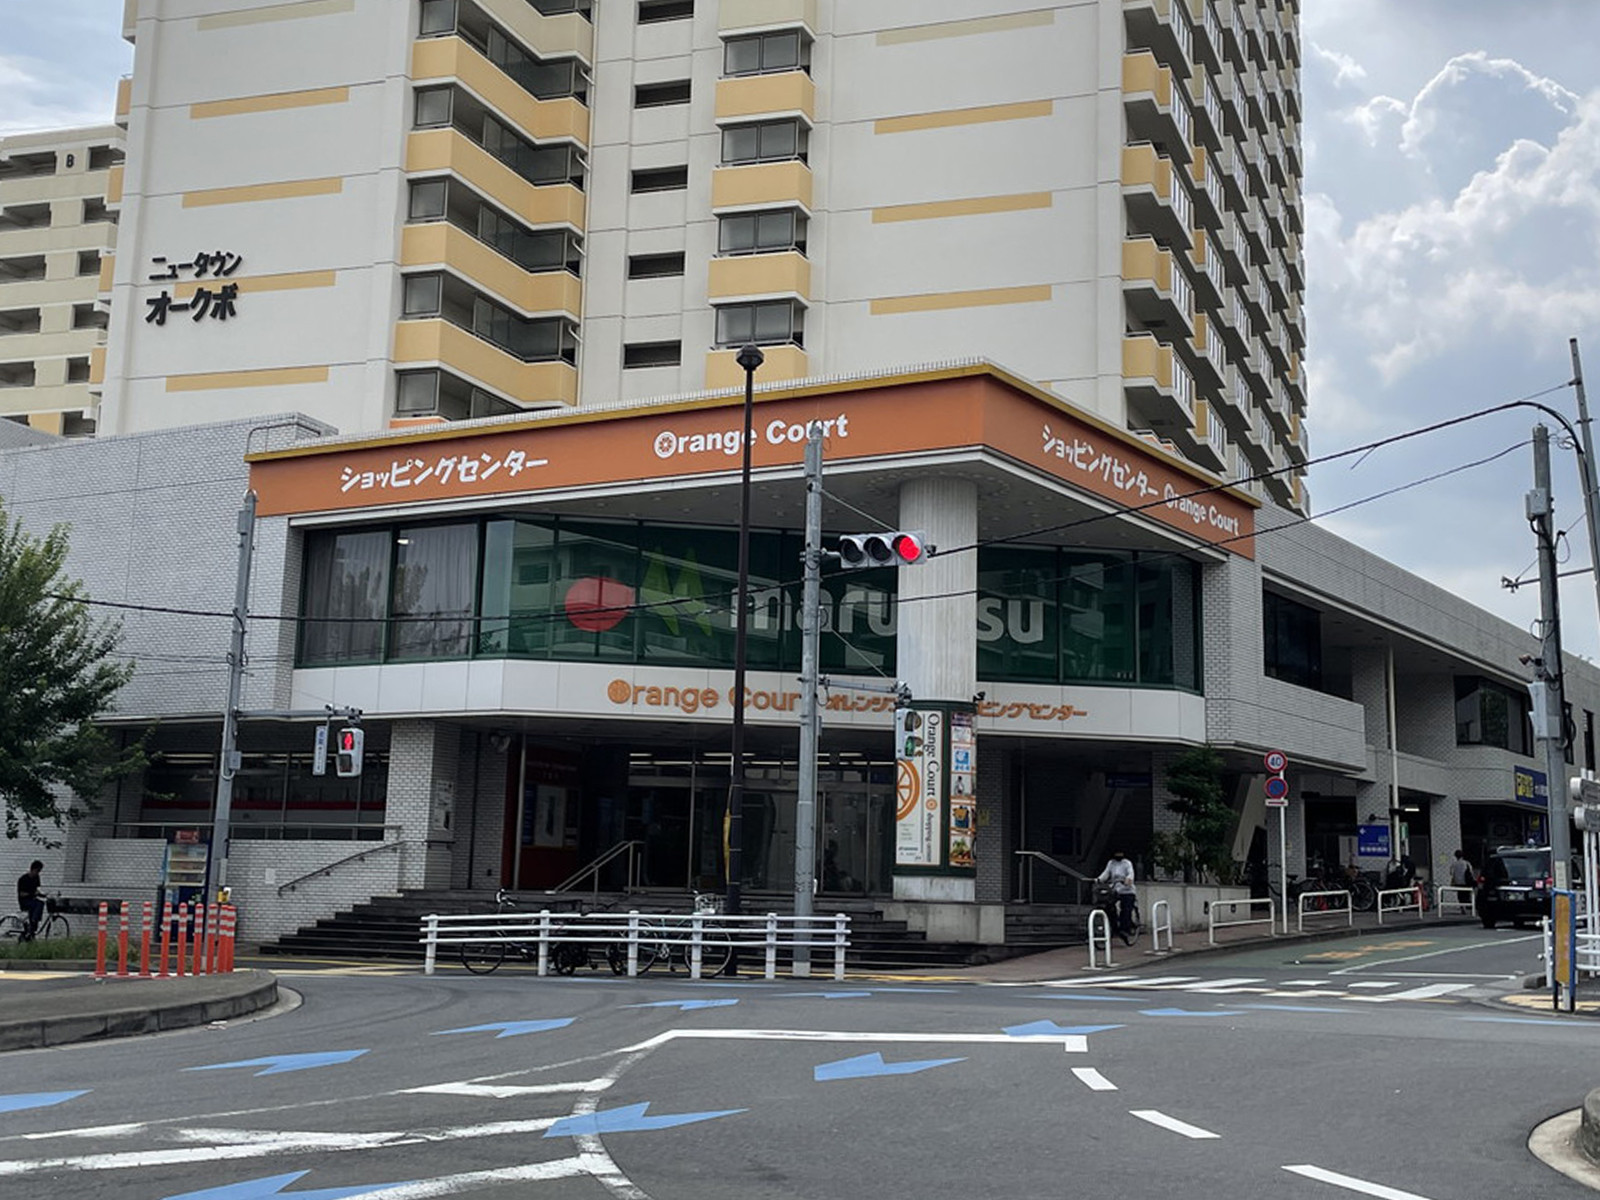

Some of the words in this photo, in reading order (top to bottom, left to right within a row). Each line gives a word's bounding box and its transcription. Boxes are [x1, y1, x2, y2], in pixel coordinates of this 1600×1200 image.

[149, 251, 242, 280] ニュータウン
[145, 283, 238, 326] オークボ
[654, 428, 758, 459] Orange
[766, 414, 848, 444] Court
[340, 450, 549, 493] ショッピングセンター
[1042, 424, 1159, 497] ショッピングセンター
[1164, 483, 1207, 524] Orange
[1208, 506, 1240, 536] Court
[607, 679, 719, 714] Orange
[728, 686, 803, 711] Cour
[923, 713, 941, 758] Orange
[926, 760, 941, 797] Court
[1270, 756, 1282, 767] 40
